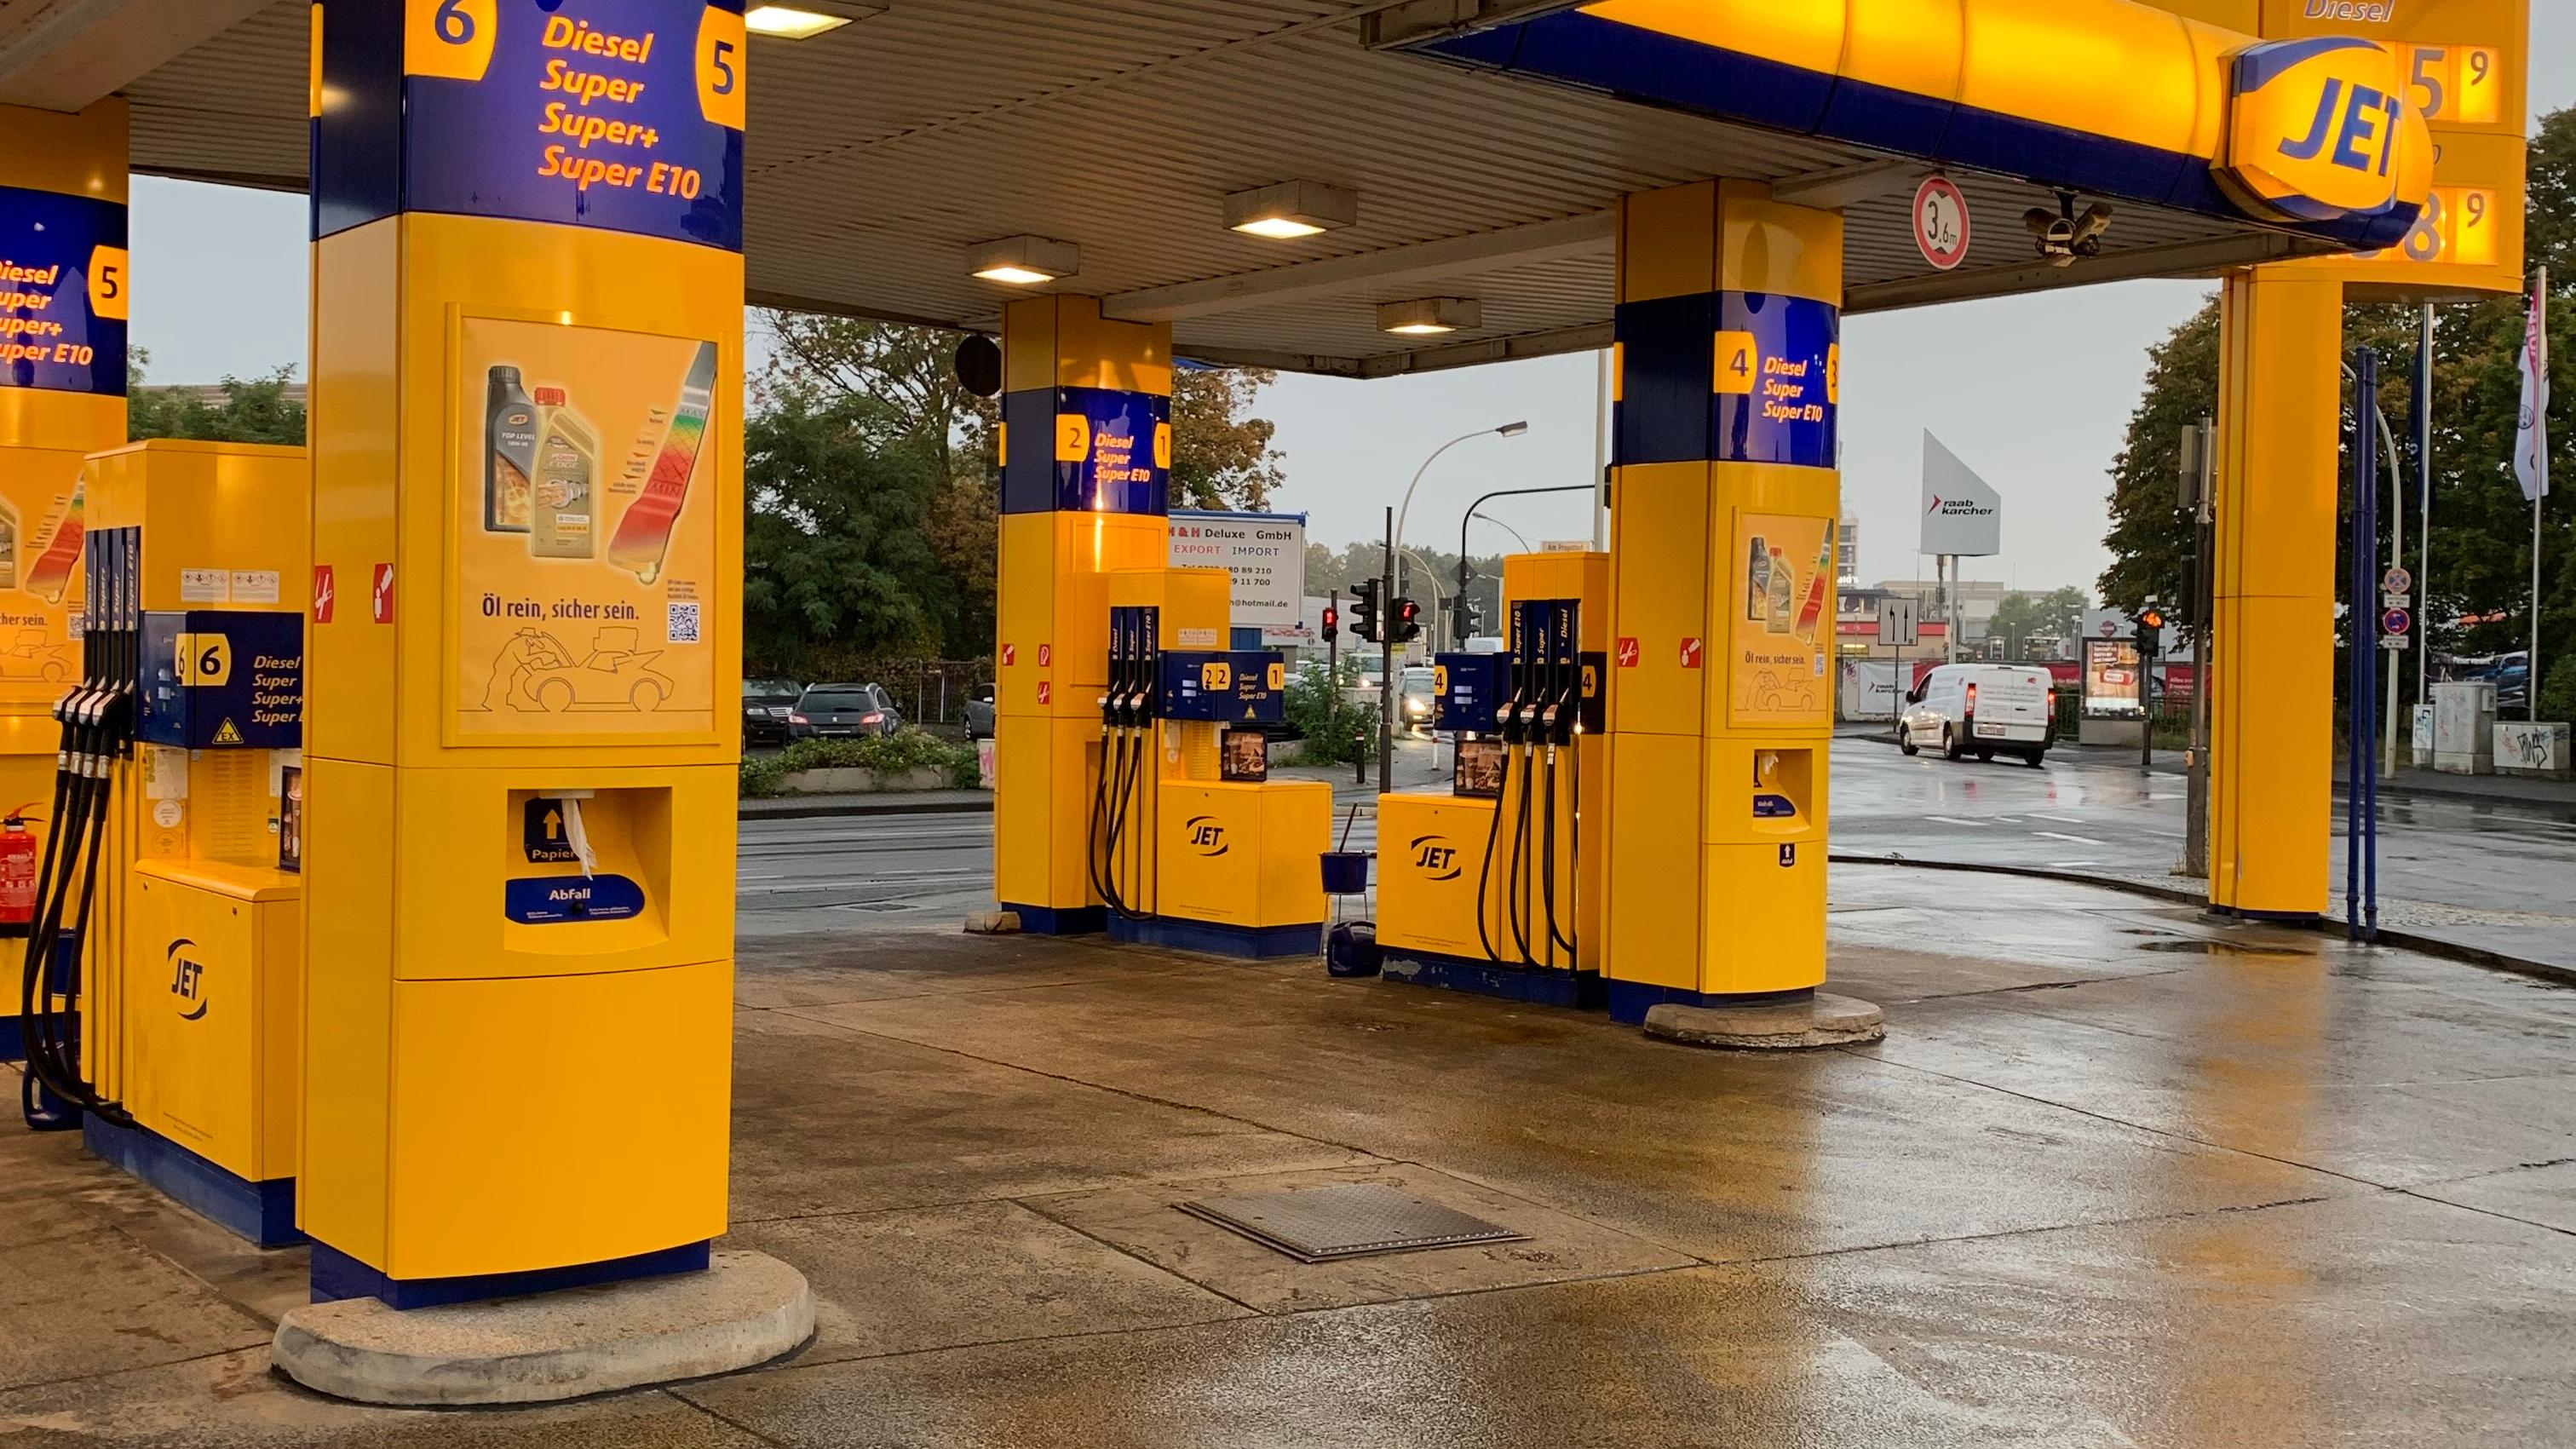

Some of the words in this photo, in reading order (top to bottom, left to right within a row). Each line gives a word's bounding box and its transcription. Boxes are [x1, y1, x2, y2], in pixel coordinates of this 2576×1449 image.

[2303, 0, 2395, 22] Diesel
[435, 0, 475, 45] 6
[542, 15, 654, 64] Diesel
[711, 39, 734, 95] 5
[539, 59, 645, 106] Super
[538, 101, 659, 148] Super+
[2277, 77, 2402, 178] JET
[538, 145, 643, 192] Super
[646, 161, 701, 200] E10
[0, 259, 60, 285] iesel
[101, 266, 118, 300] 5
[0, 290, 53, 313] uper
[0, 316, 63, 339] uper+
[0, 342, 51, 365] uper
[53, 342, 94, 366] E10
[1729, 348, 1750, 377] 4
[1763, 356, 1808, 377] Diesel
[1762, 378, 1804, 401] Super
[1762, 400, 1803, 423] Super
[1803, 404, 1823, 423] E10
[1068, 427, 1082, 449] 2
[1095, 432, 1135, 450] Diesel
[1160, 434, 1166, 457] 1
[1093, 449, 1131, 468] Super
[1093, 465, 1131, 484] Super
[1130, 468, 1151, 483] E10
[650, 482, 681, 498] MIN
[1941, 506, 1994, 515] karcher
[1943, 498, 1975, 507] raab
[1178, 526, 1189, 538] &
[1191, 526, 1200, 538] H
[1205, 528, 1245, 539] Deluxe
[1256, 529, 1292, 540] GmbH
[1174, 544, 1222, 555] EXPORT
[1232, 546, 1279, 556] IMPORT
[481, 592, 501, 617] Öl
[506, 597, 547, 622] rein,
[551, 598, 601, 619] sicher
[603, 600, 640, 620] sein.
[22, 613, 48, 627] sein.
[1514, 627, 1523, 655] Super
[1537, 626, 1546, 655] Super
[198, 645, 221, 676] 6
[253, 654, 302, 670] Diesel
[1745, 650, 1754, 664] Öl
[1755, 652, 1773, 665] rein,
[1774, 652, 1792, 664] sicher
[1791, 653, 1805, 665] sein.
[252, 673, 298, 691] Super
[1205, 669, 1212, 684] 2
[1218, 669, 1227, 685] 2
[1239, 672, 1258, 681] Diesel
[1273, 669, 1278, 685] 1
[1435, 672, 1444, 689] 4
[1583, 673, 1592, 692] 4
[1239, 682, 1256, 693] Super
[1239, 692, 1256, 701] Super
[252, 691, 304, 709] Super+
[251, 709, 296, 727] Super
[221, 731, 235, 742] EX
[1190, 825, 1224, 847] JET
[1415, 846, 1457, 870] JET
[549, 888, 591, 901] Abfall
[170, 957, 203, 1002] JET
